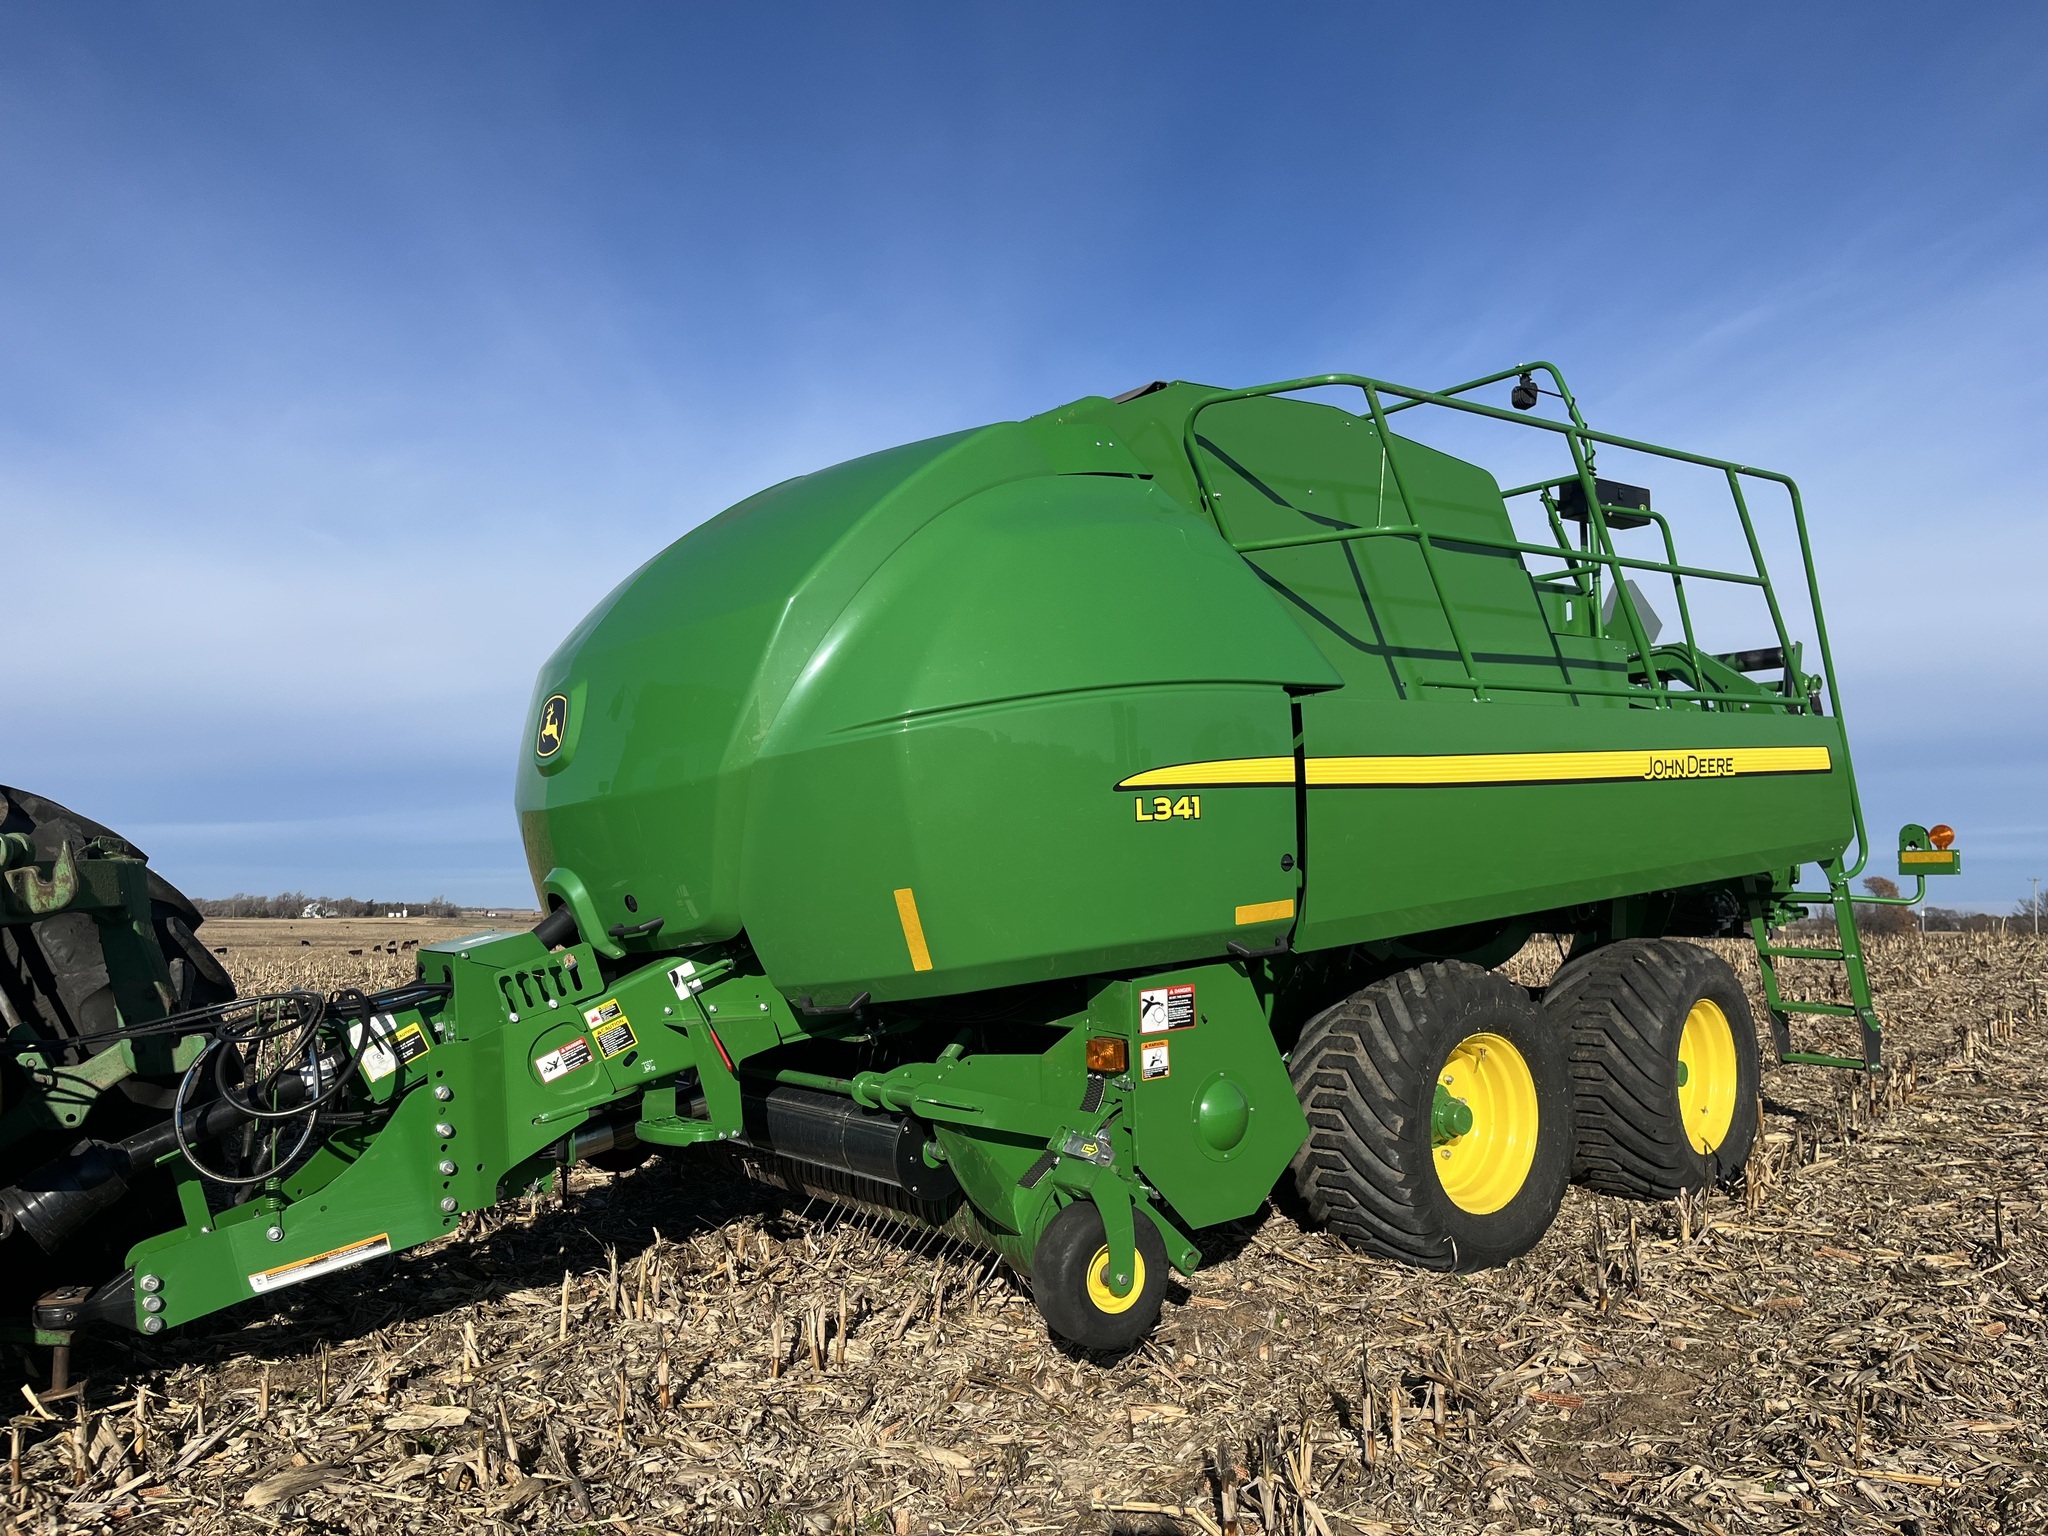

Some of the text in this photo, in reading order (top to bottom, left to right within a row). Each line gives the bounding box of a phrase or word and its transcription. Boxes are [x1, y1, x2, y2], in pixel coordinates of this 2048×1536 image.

[1644, 755, 1734, 777] JOHN DEERE
[1135, 795, 1201, 822] L341
[601, 1018, 624, 1033] CAUTION
